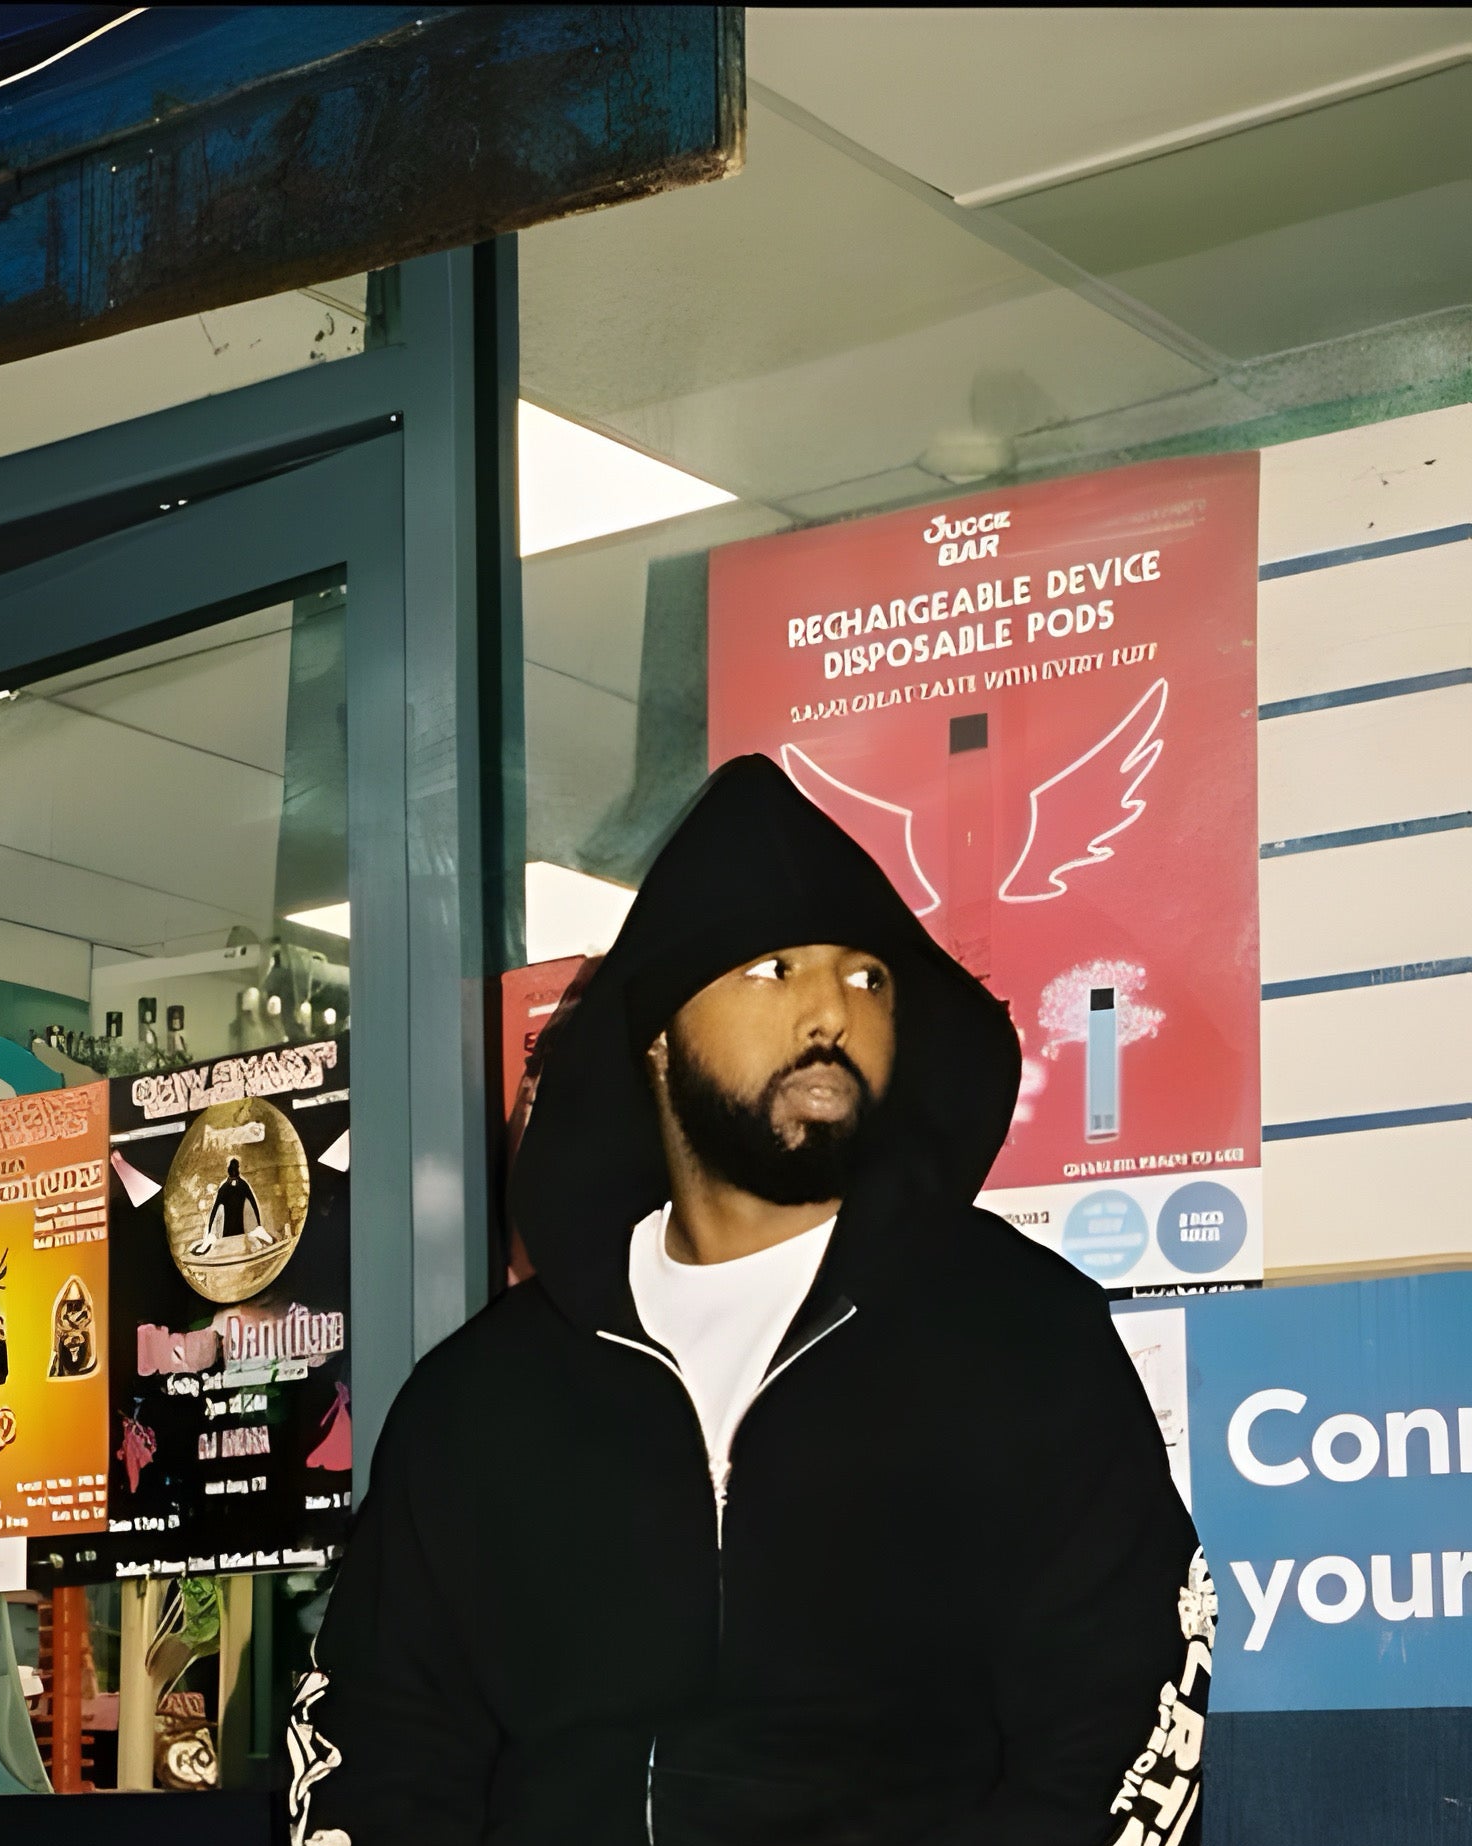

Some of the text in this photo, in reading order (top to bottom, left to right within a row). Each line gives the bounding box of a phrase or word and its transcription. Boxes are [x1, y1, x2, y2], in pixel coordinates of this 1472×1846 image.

[938, 534, 1000, 567] BAR
[788, 550, 1161, 648] RECHARGEABLE DEVICE
[824, 600, 1115, 679] DISPOSABLE PODS
[1227, 1388, 1472, 1486] Con
